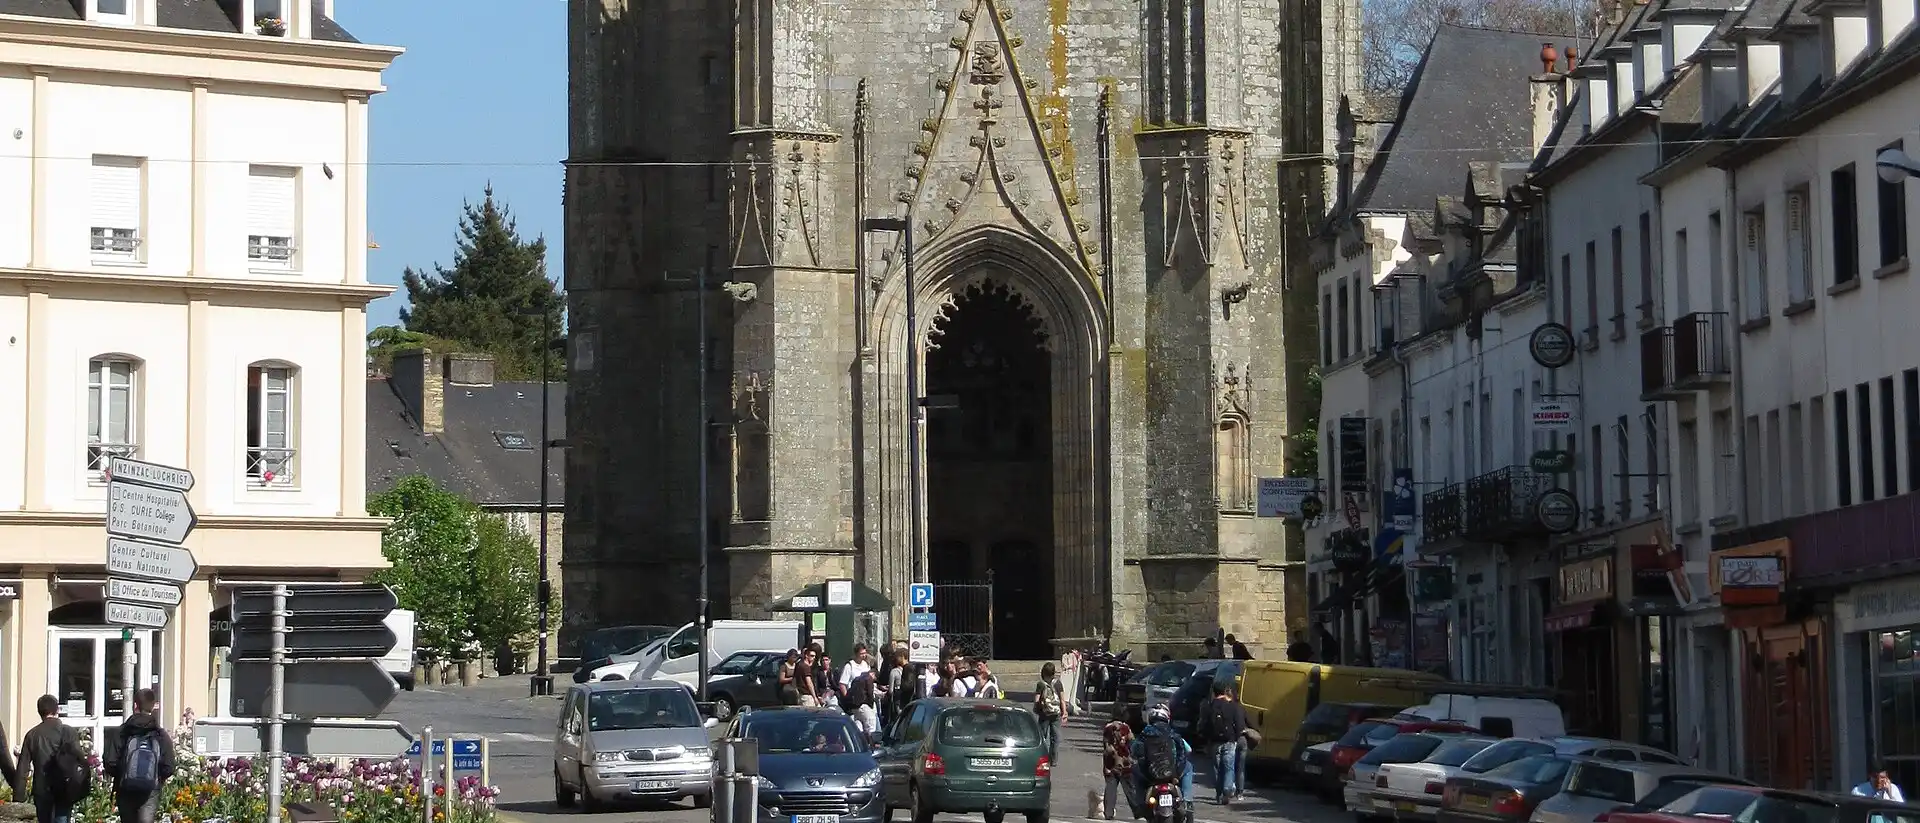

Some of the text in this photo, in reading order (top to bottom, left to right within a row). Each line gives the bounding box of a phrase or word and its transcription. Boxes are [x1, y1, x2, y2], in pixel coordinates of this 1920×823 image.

[122, 488, 181, 508] Centre Hospitalier
[131, 505, 153, 518] CURIE
[111, 516, 168, 535] Parc Botanique
[111, 543, 171, 561] Centre Culturel
[111, 556, 132, 570] Haras
[121, 584, 177, 600] Office du Tourisme
[133, 611, 142, 621] de
[146, 611, 163, 623] Ville
